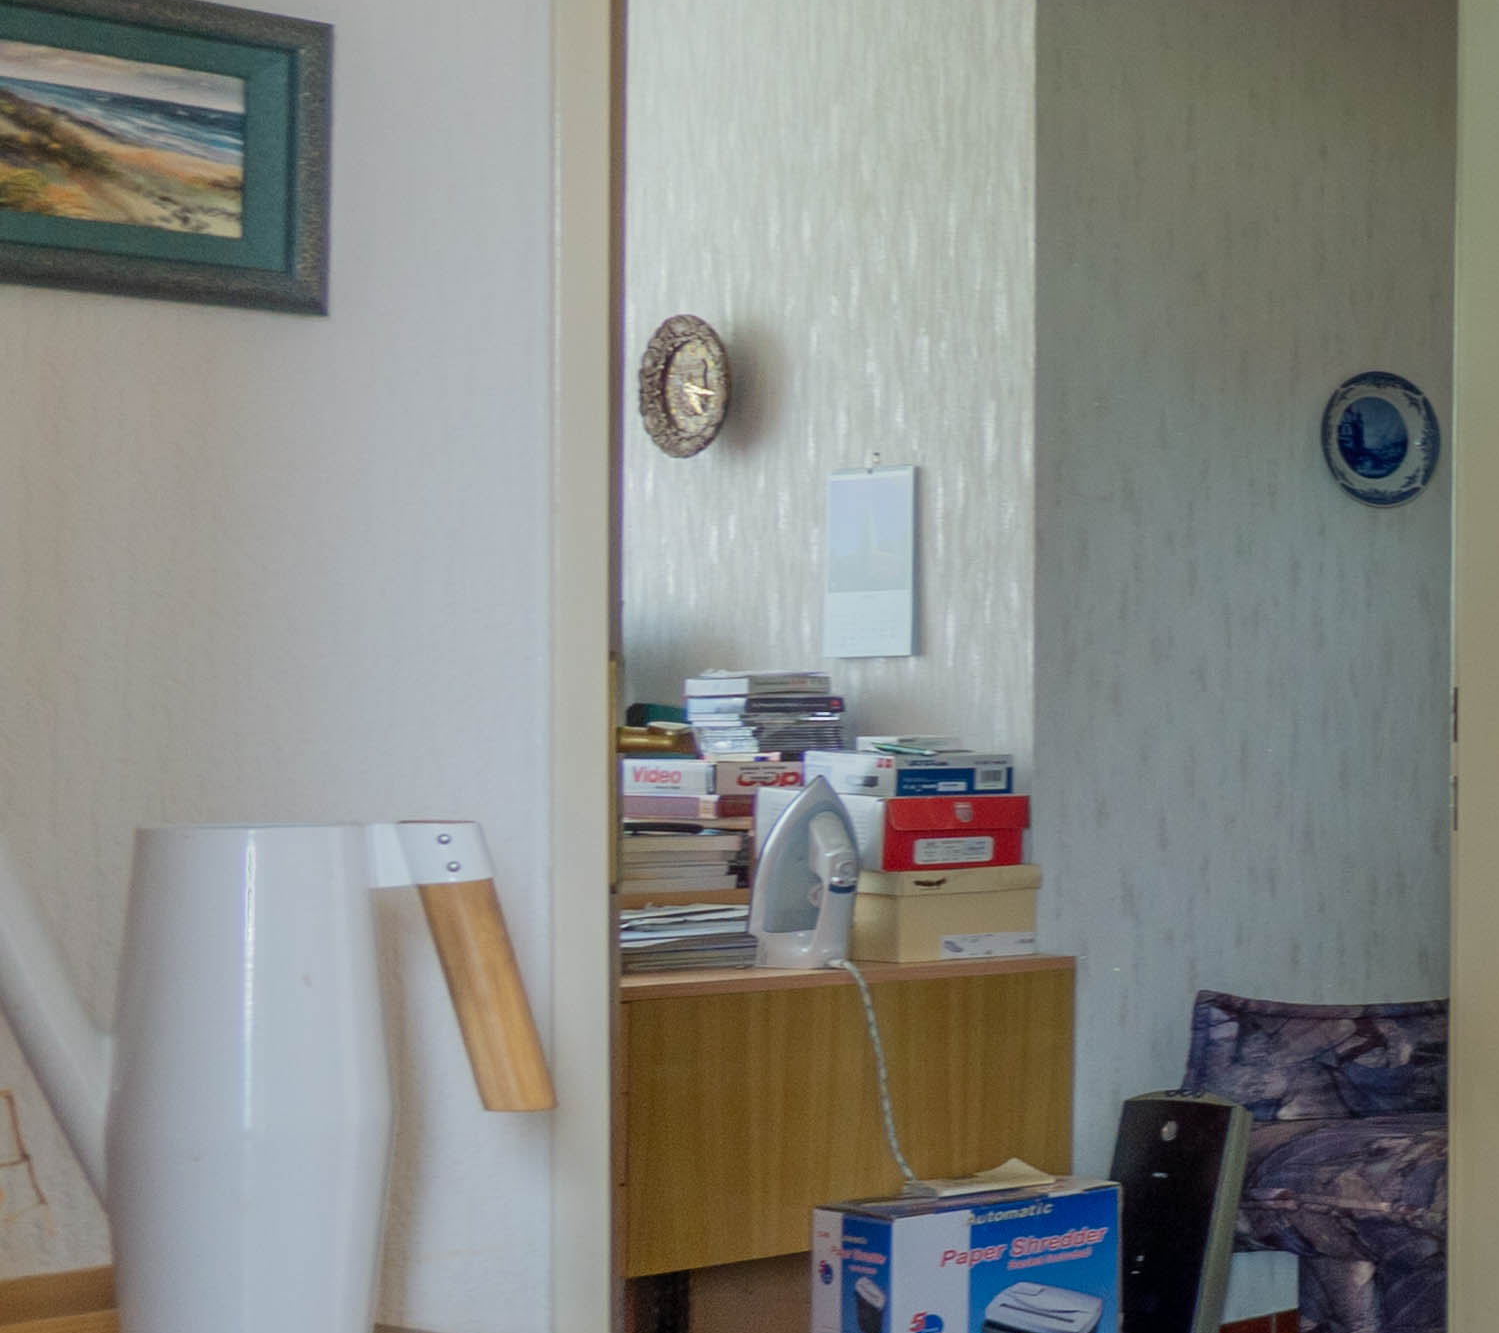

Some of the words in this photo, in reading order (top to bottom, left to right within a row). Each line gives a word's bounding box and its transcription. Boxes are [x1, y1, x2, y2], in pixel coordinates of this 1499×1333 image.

[632, 766, 683, 784] Video
[966, 1201, 1055, 1225] Automatic
[939, 1243, 1007, 1269] Paper
[1010, 1226, 1109, 1258] Shredder
